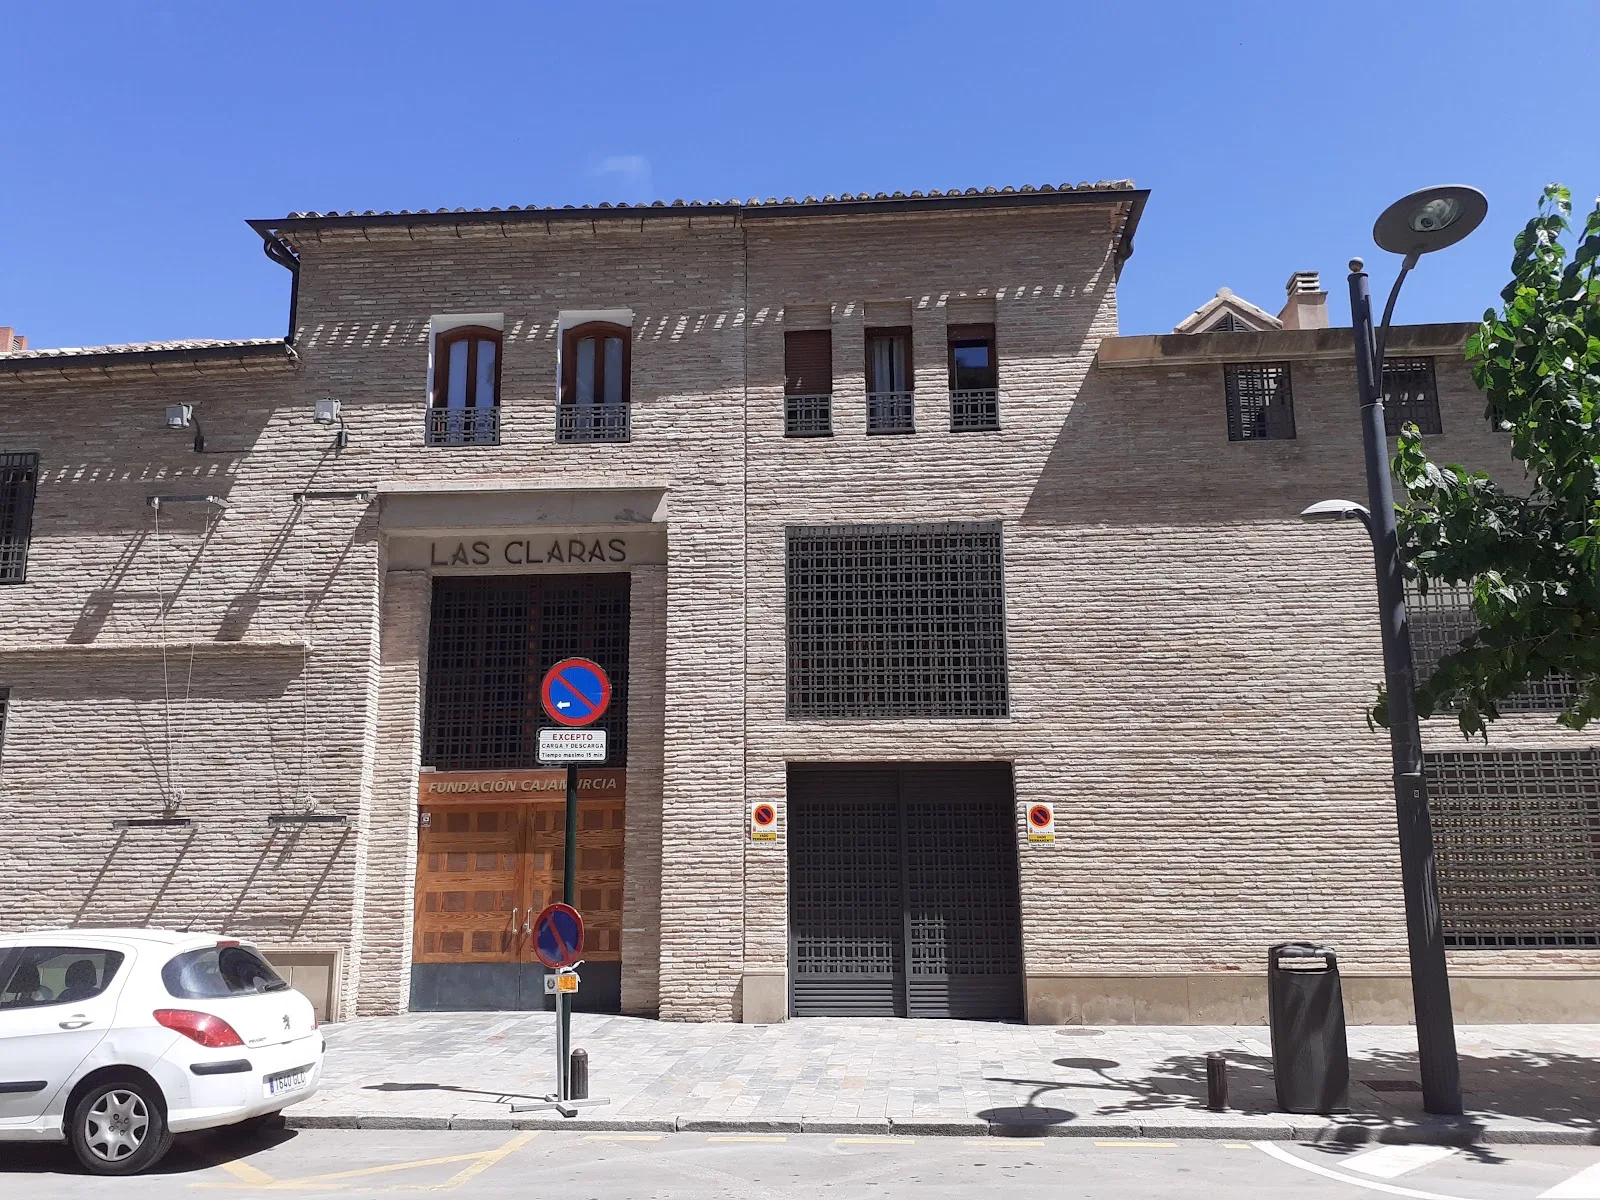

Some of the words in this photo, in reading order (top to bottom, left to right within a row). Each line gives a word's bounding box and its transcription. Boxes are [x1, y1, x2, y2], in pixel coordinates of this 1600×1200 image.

[430, 542, 490, 566] LAS
[504, 538, 626, 565] CLARAS
[552, 733, 593, 741] EXCEPTO
[428, 778, 517, 794] FUNDACIÓN
[275, 1075, 292, 1091] 1640
